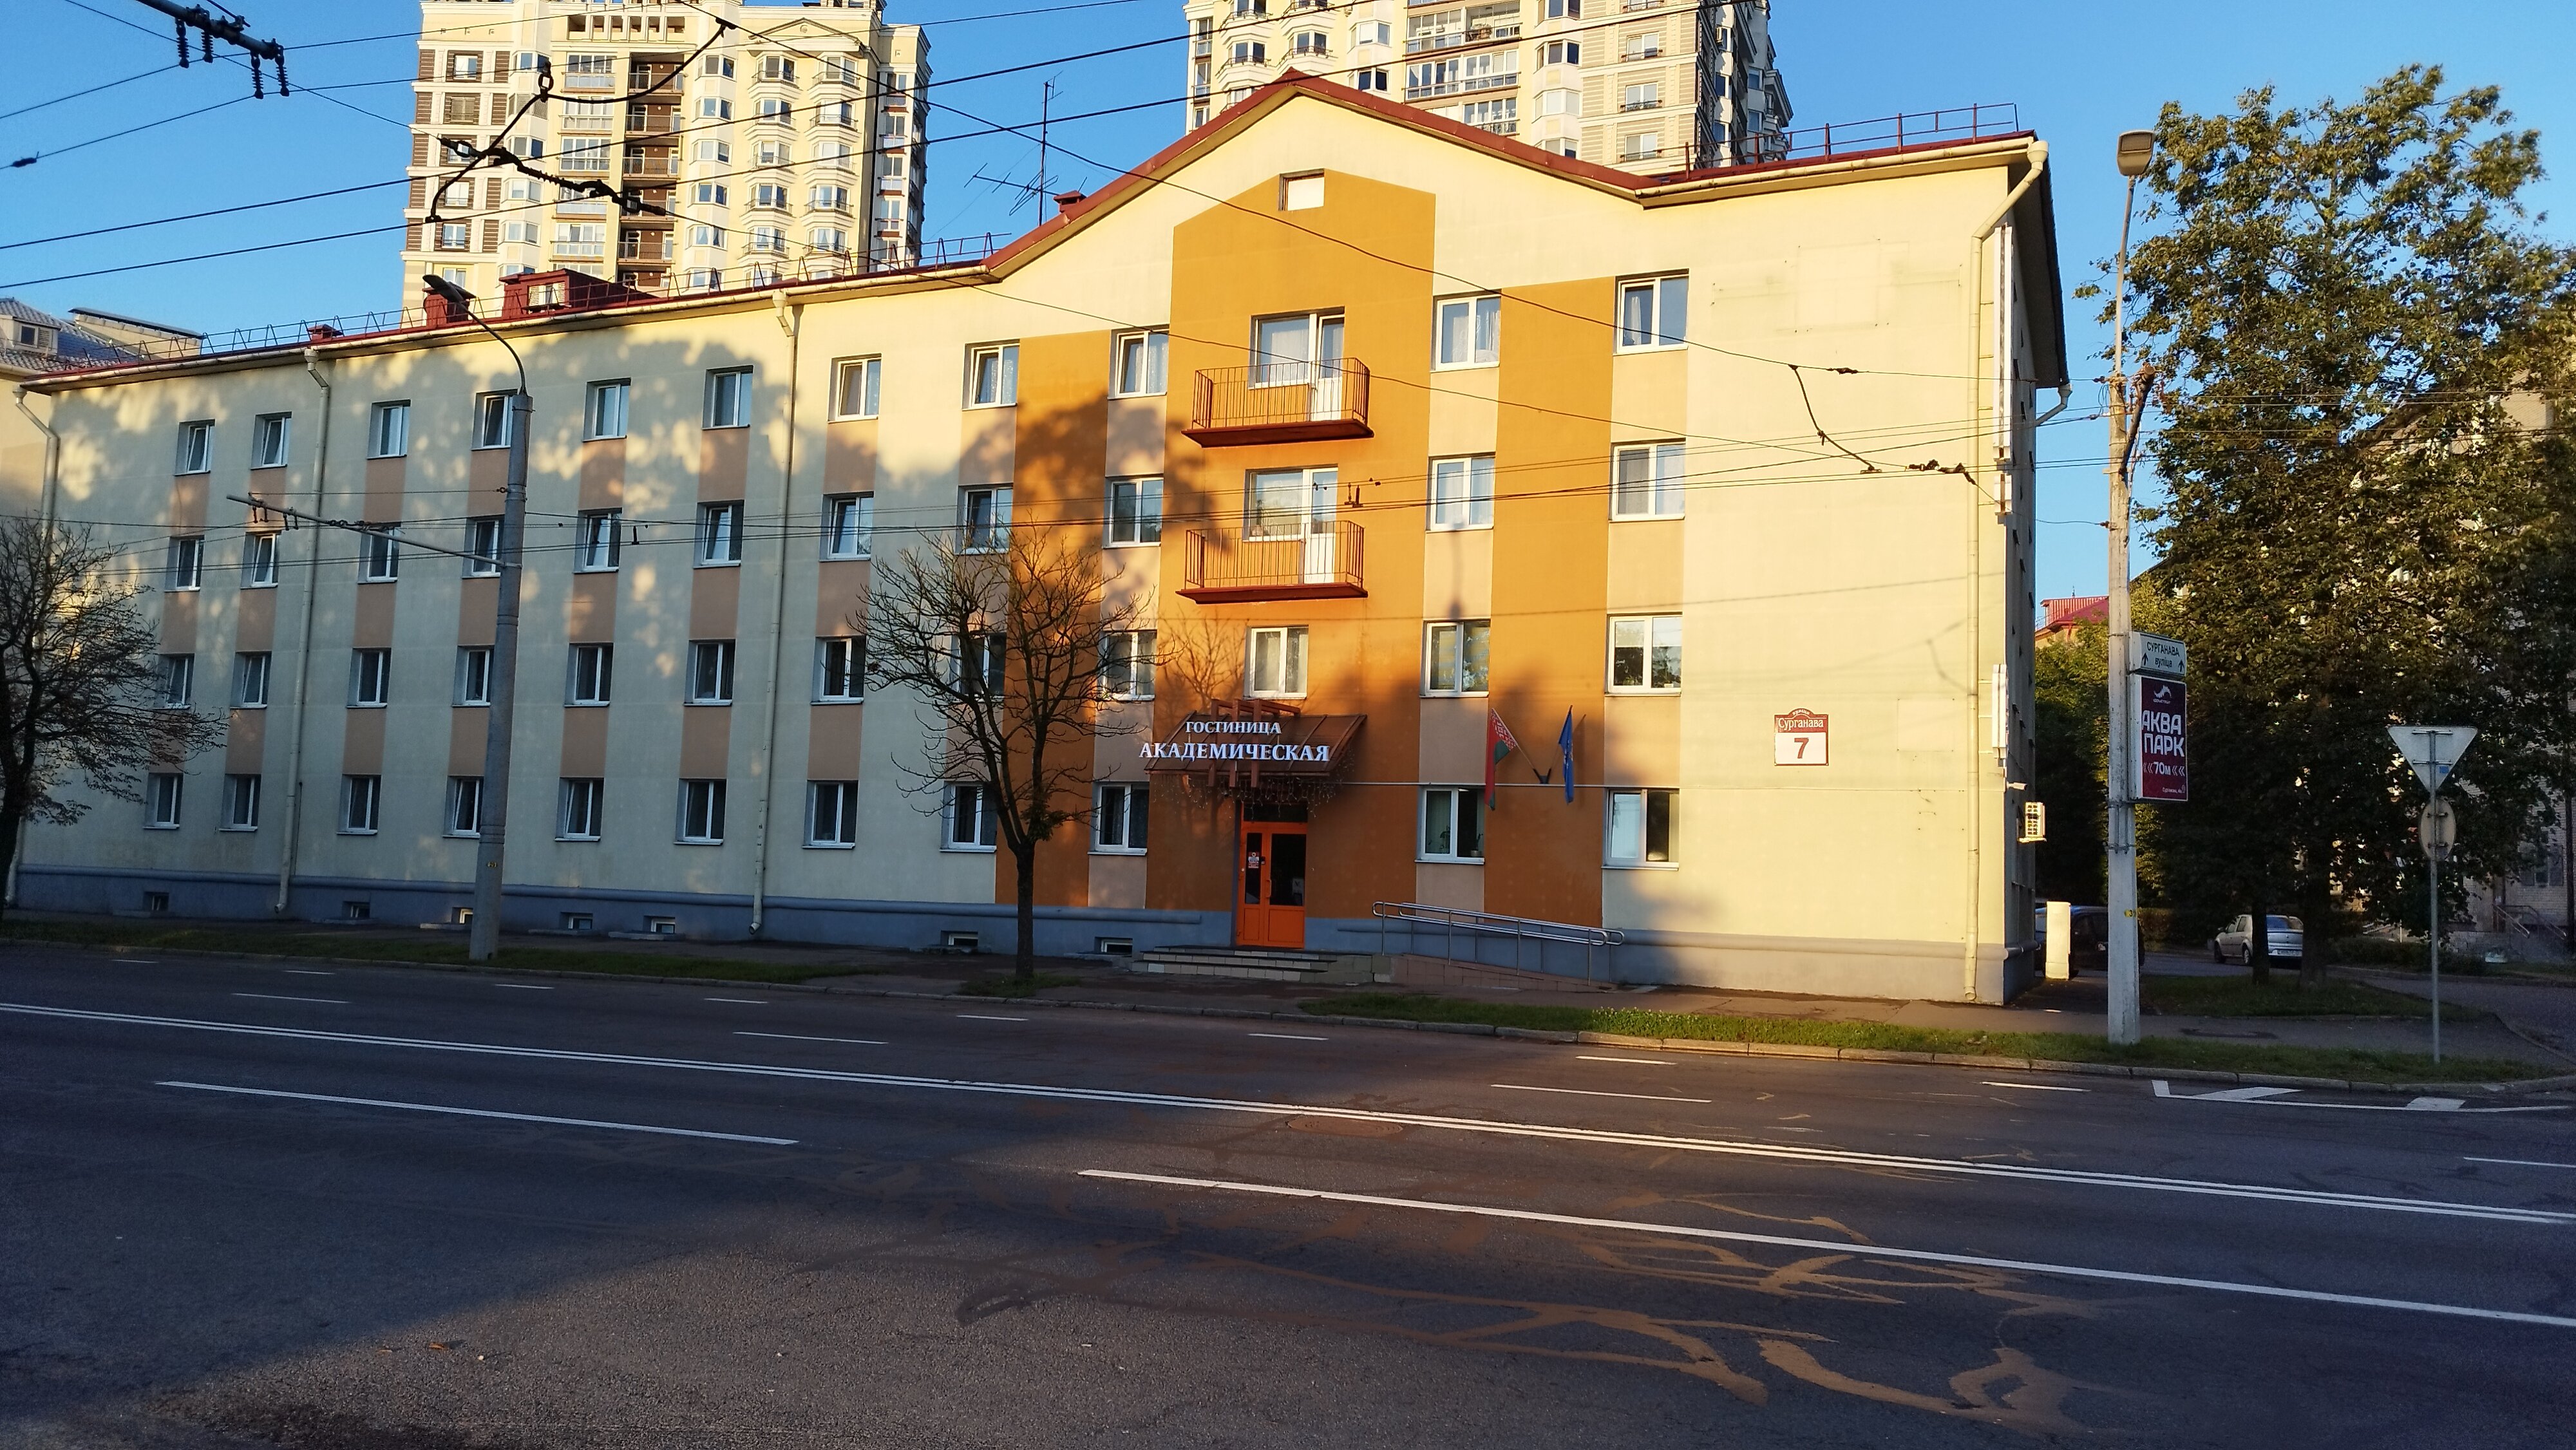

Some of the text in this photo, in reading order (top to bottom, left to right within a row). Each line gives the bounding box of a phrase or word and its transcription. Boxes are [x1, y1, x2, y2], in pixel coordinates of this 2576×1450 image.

[2147, 641, 2180, 657] СУРГАНАВА
[1185, 721, 1282, 735] ГОСТИНИЦА
[1778, 718, 1824, 731] Сурганава
[2142, 710, 2181, 735] АКВА
[1139, 742, 1330, 762] АКАДЕМИЧЕСКАЯ
[1794, 737, 1809, 758] 7
[2145, 733, 2184, 757] ПАРК
